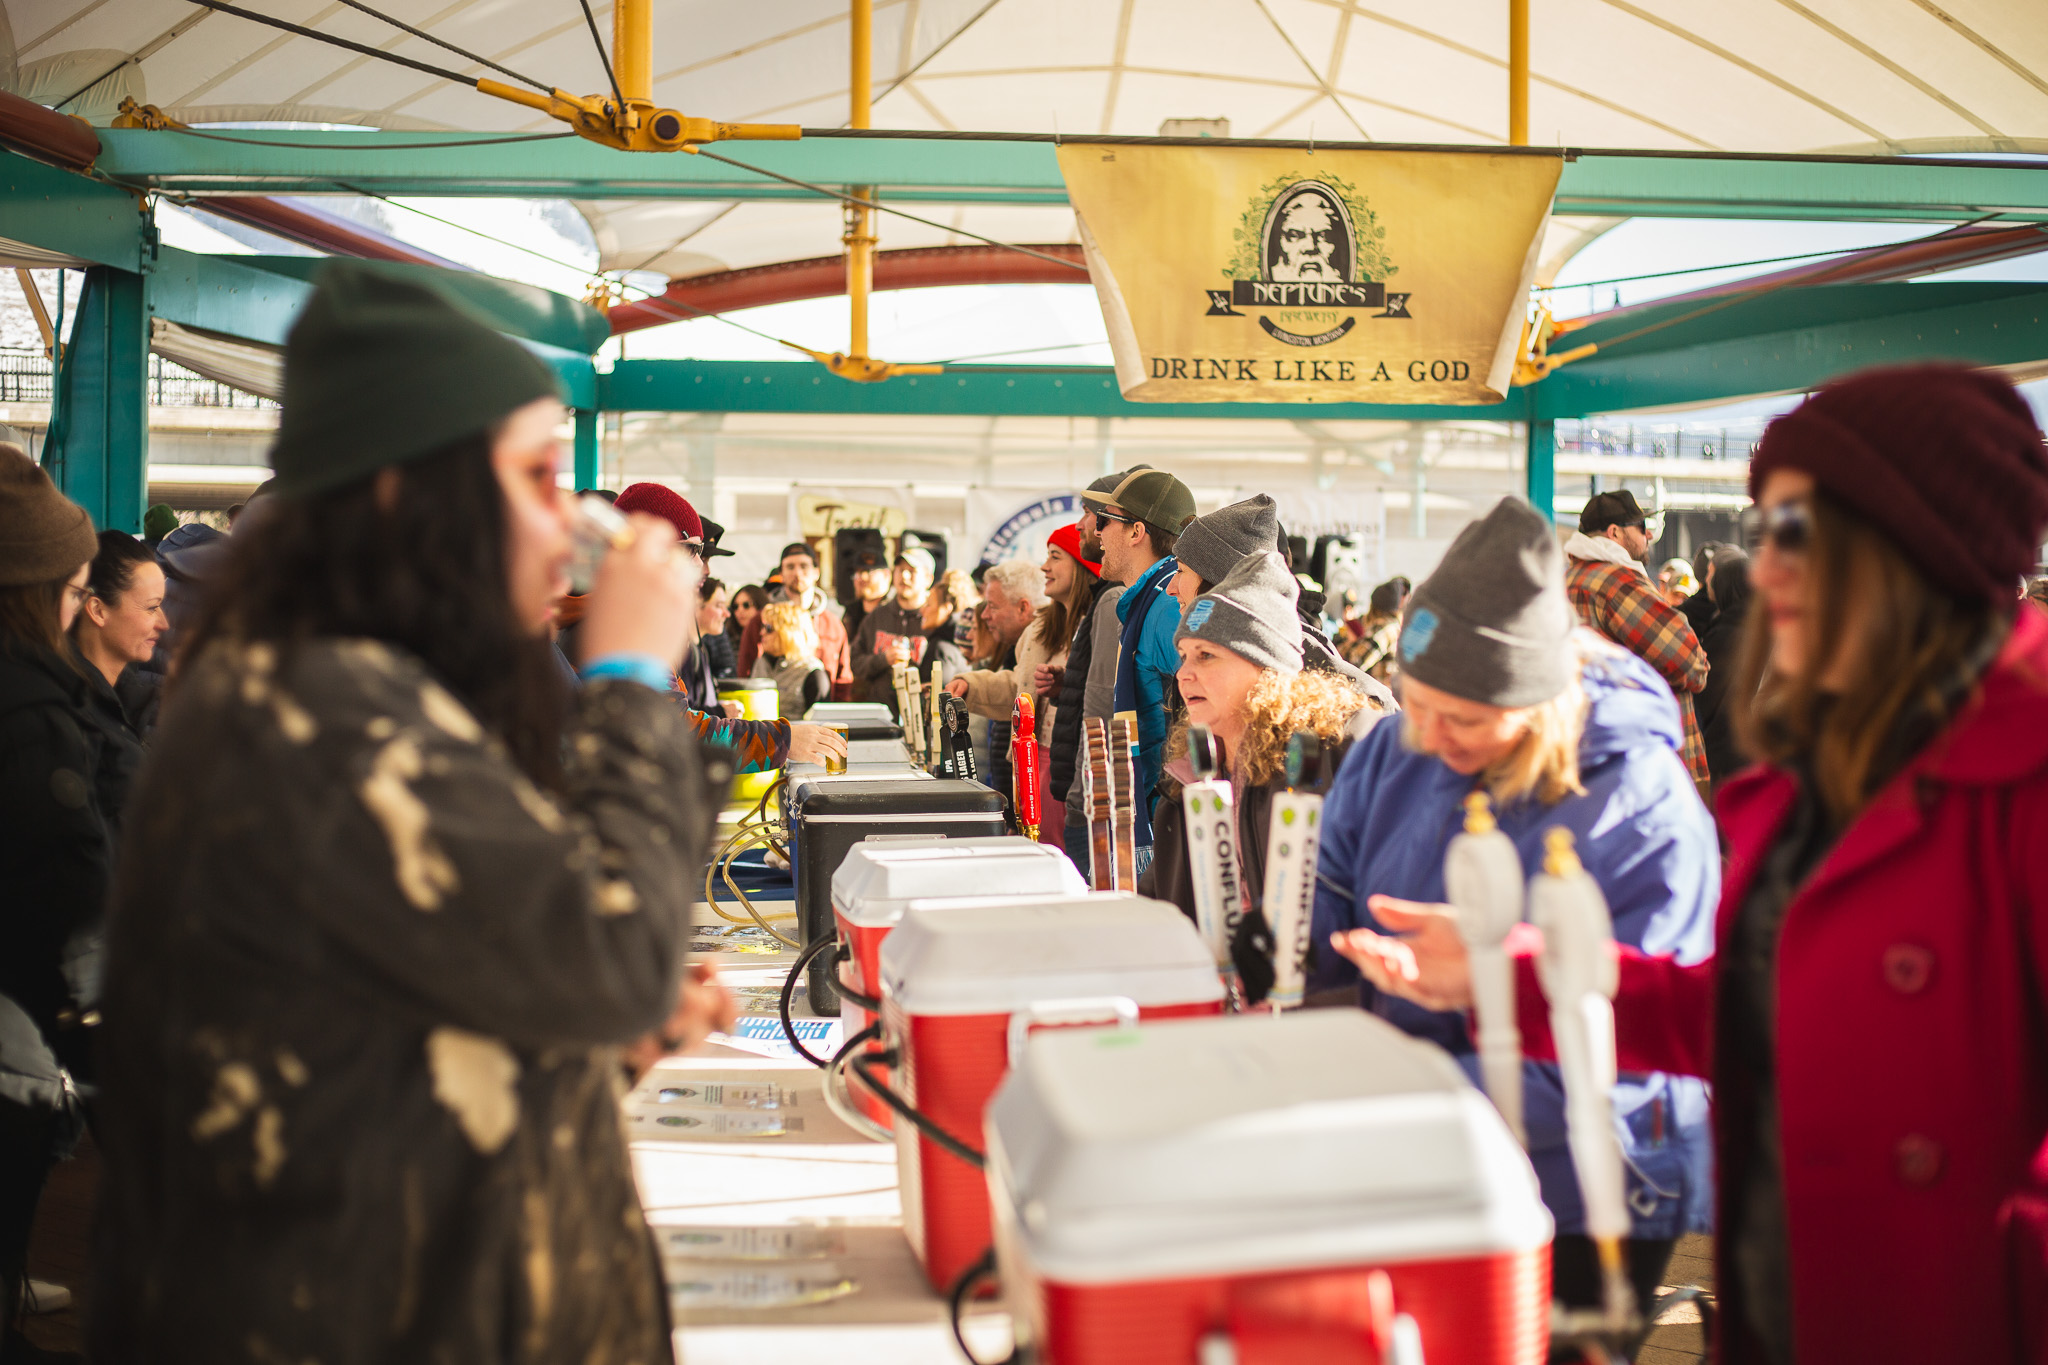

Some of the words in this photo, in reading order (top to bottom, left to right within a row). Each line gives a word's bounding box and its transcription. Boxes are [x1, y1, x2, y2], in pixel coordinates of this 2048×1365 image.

[1252, 283, 1367, 305] NEPTUNE'S
[1280, 310, 1339, 324] BREWERY
[1151, 357, 1259, 380] DRINK
[1273, 359, 1356, 381] LIKE
[1370, 360, 1392, 382] A
[1407, 360, 1470, 382] GOD
[945, 759, 954, 773] IPA
[955, 750, 969, 776] LAGER
[968, 747, 977, 773] LAGER
